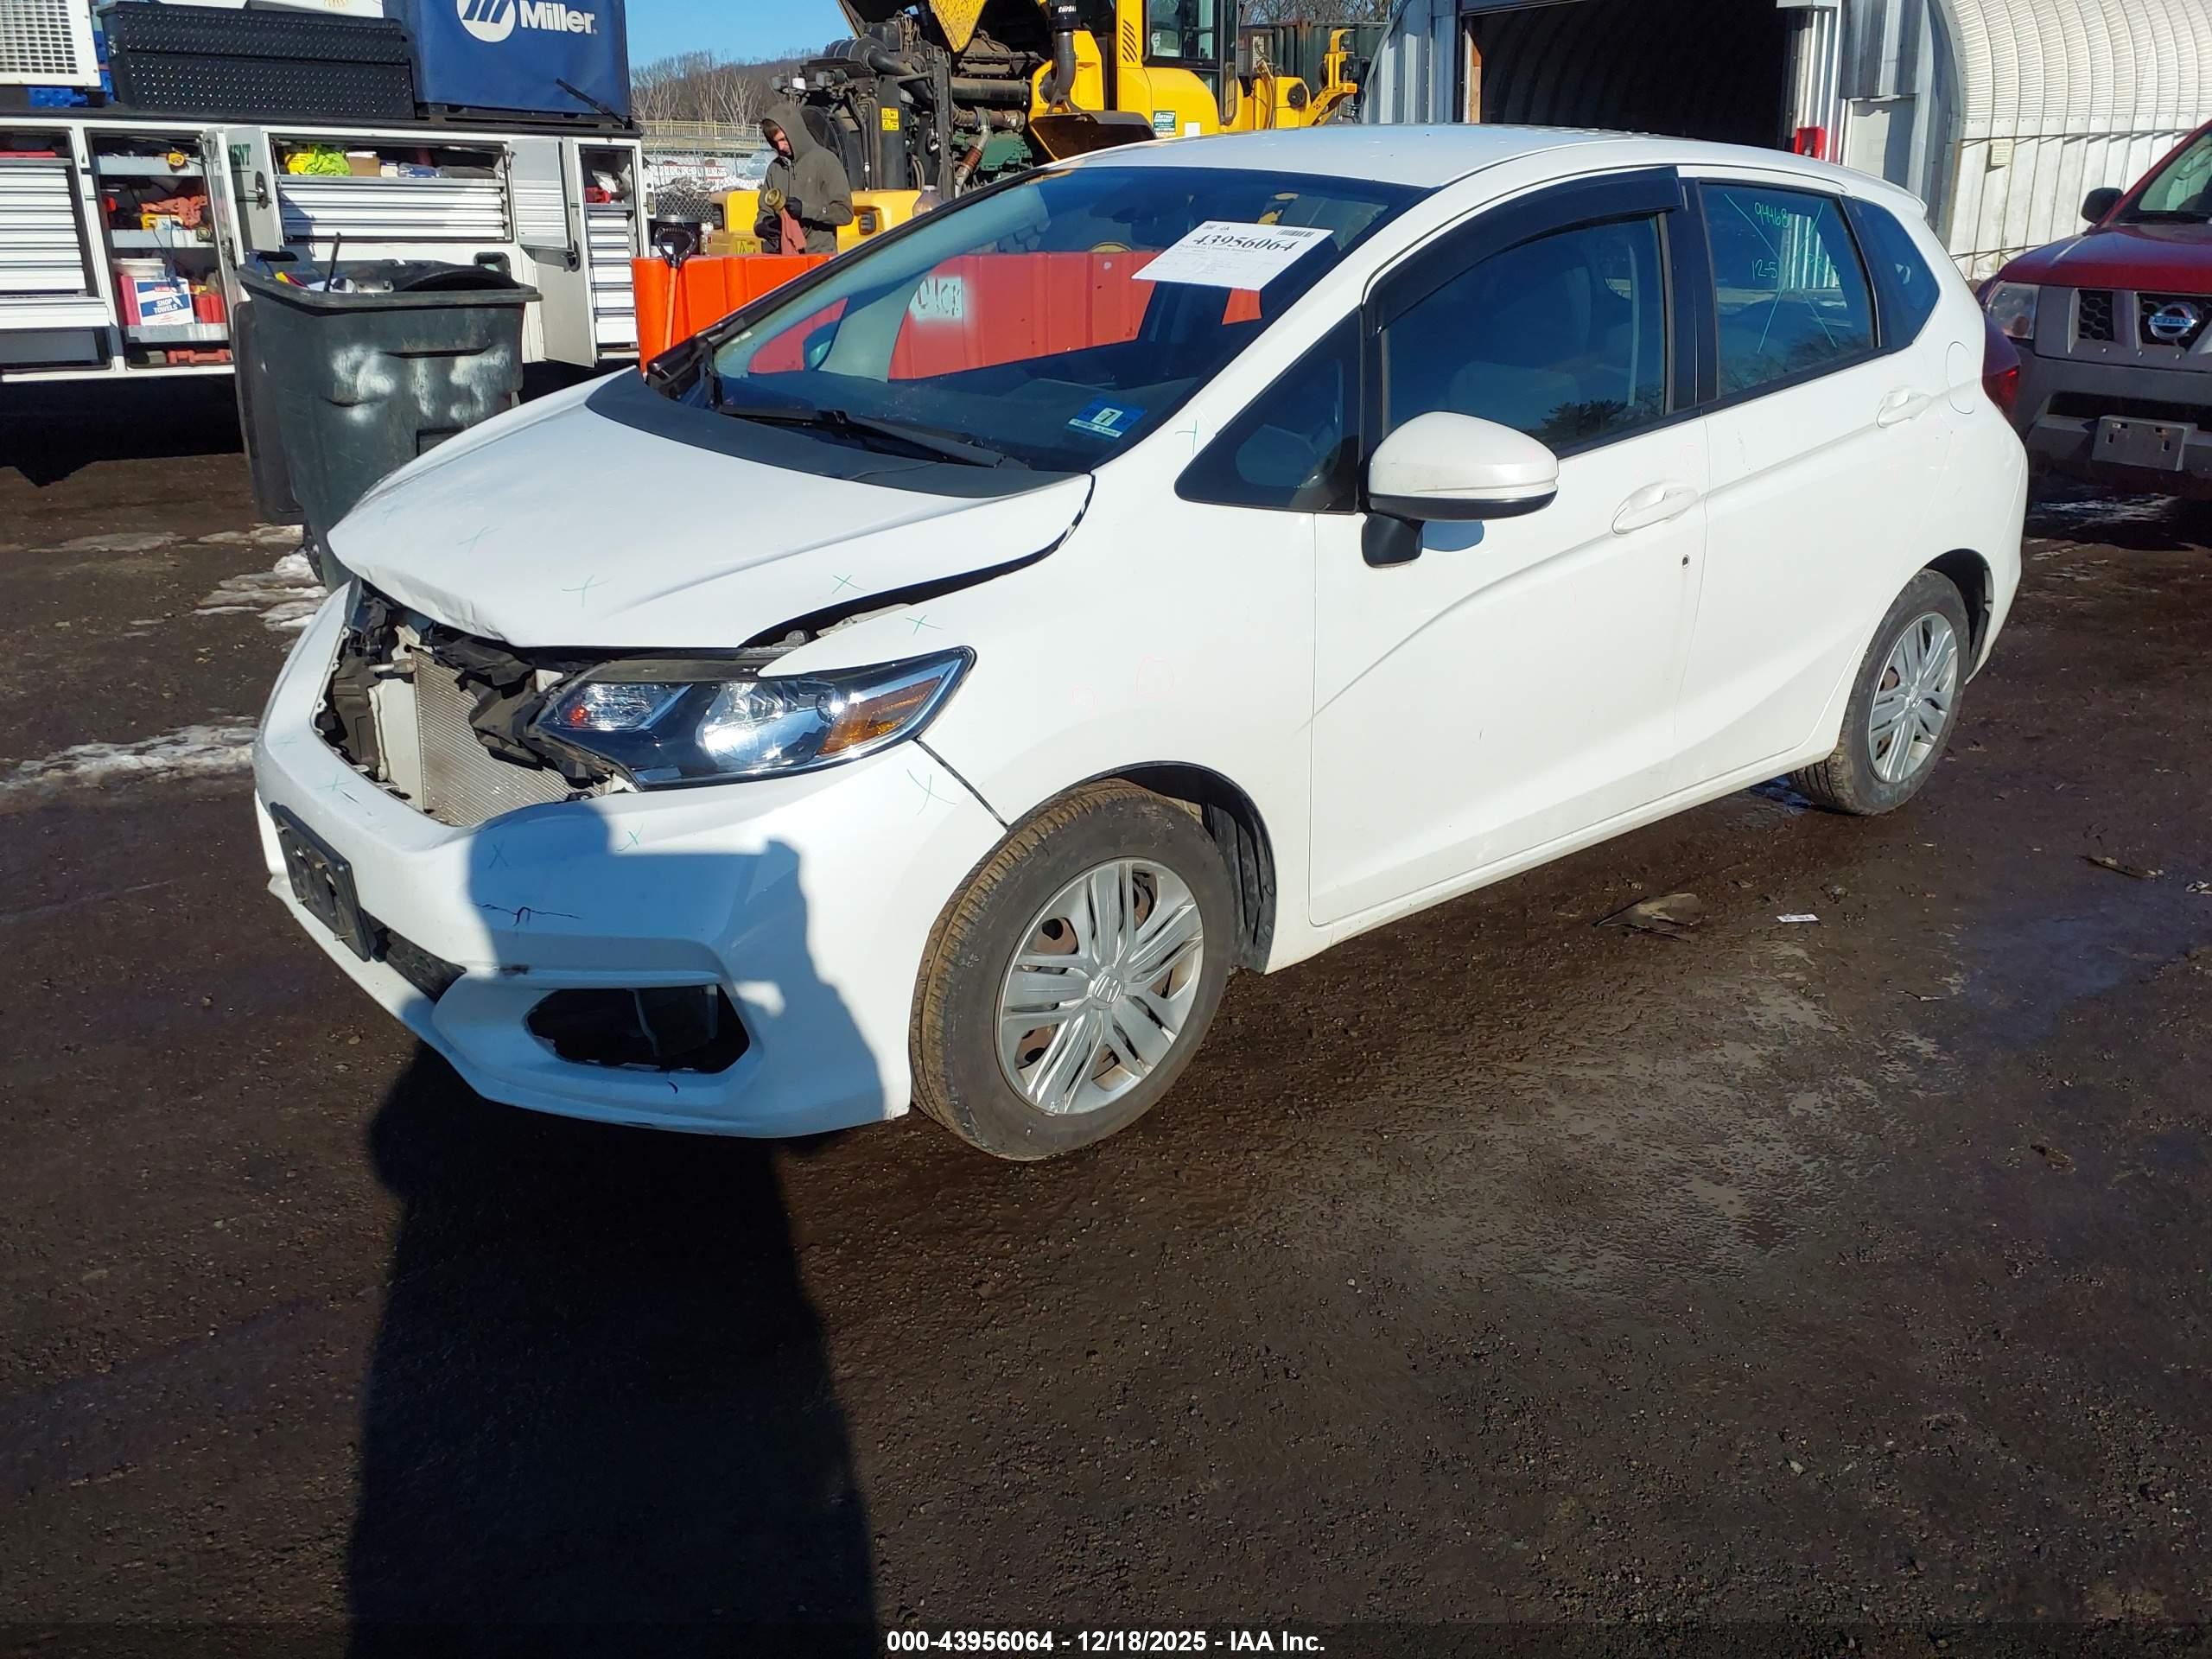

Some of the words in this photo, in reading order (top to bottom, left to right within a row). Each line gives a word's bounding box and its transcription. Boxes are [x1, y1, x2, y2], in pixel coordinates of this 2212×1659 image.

[520, 0, 595, 35] Miller
[1754, 201, 1790, 228] 94468
[1192, 233, 1300, 253] 43956064
[1751, 259, 1778, 283] 12-5
[153, 303, 178, 314] TOWELS
[156, 297, 173, 307] SHOP
